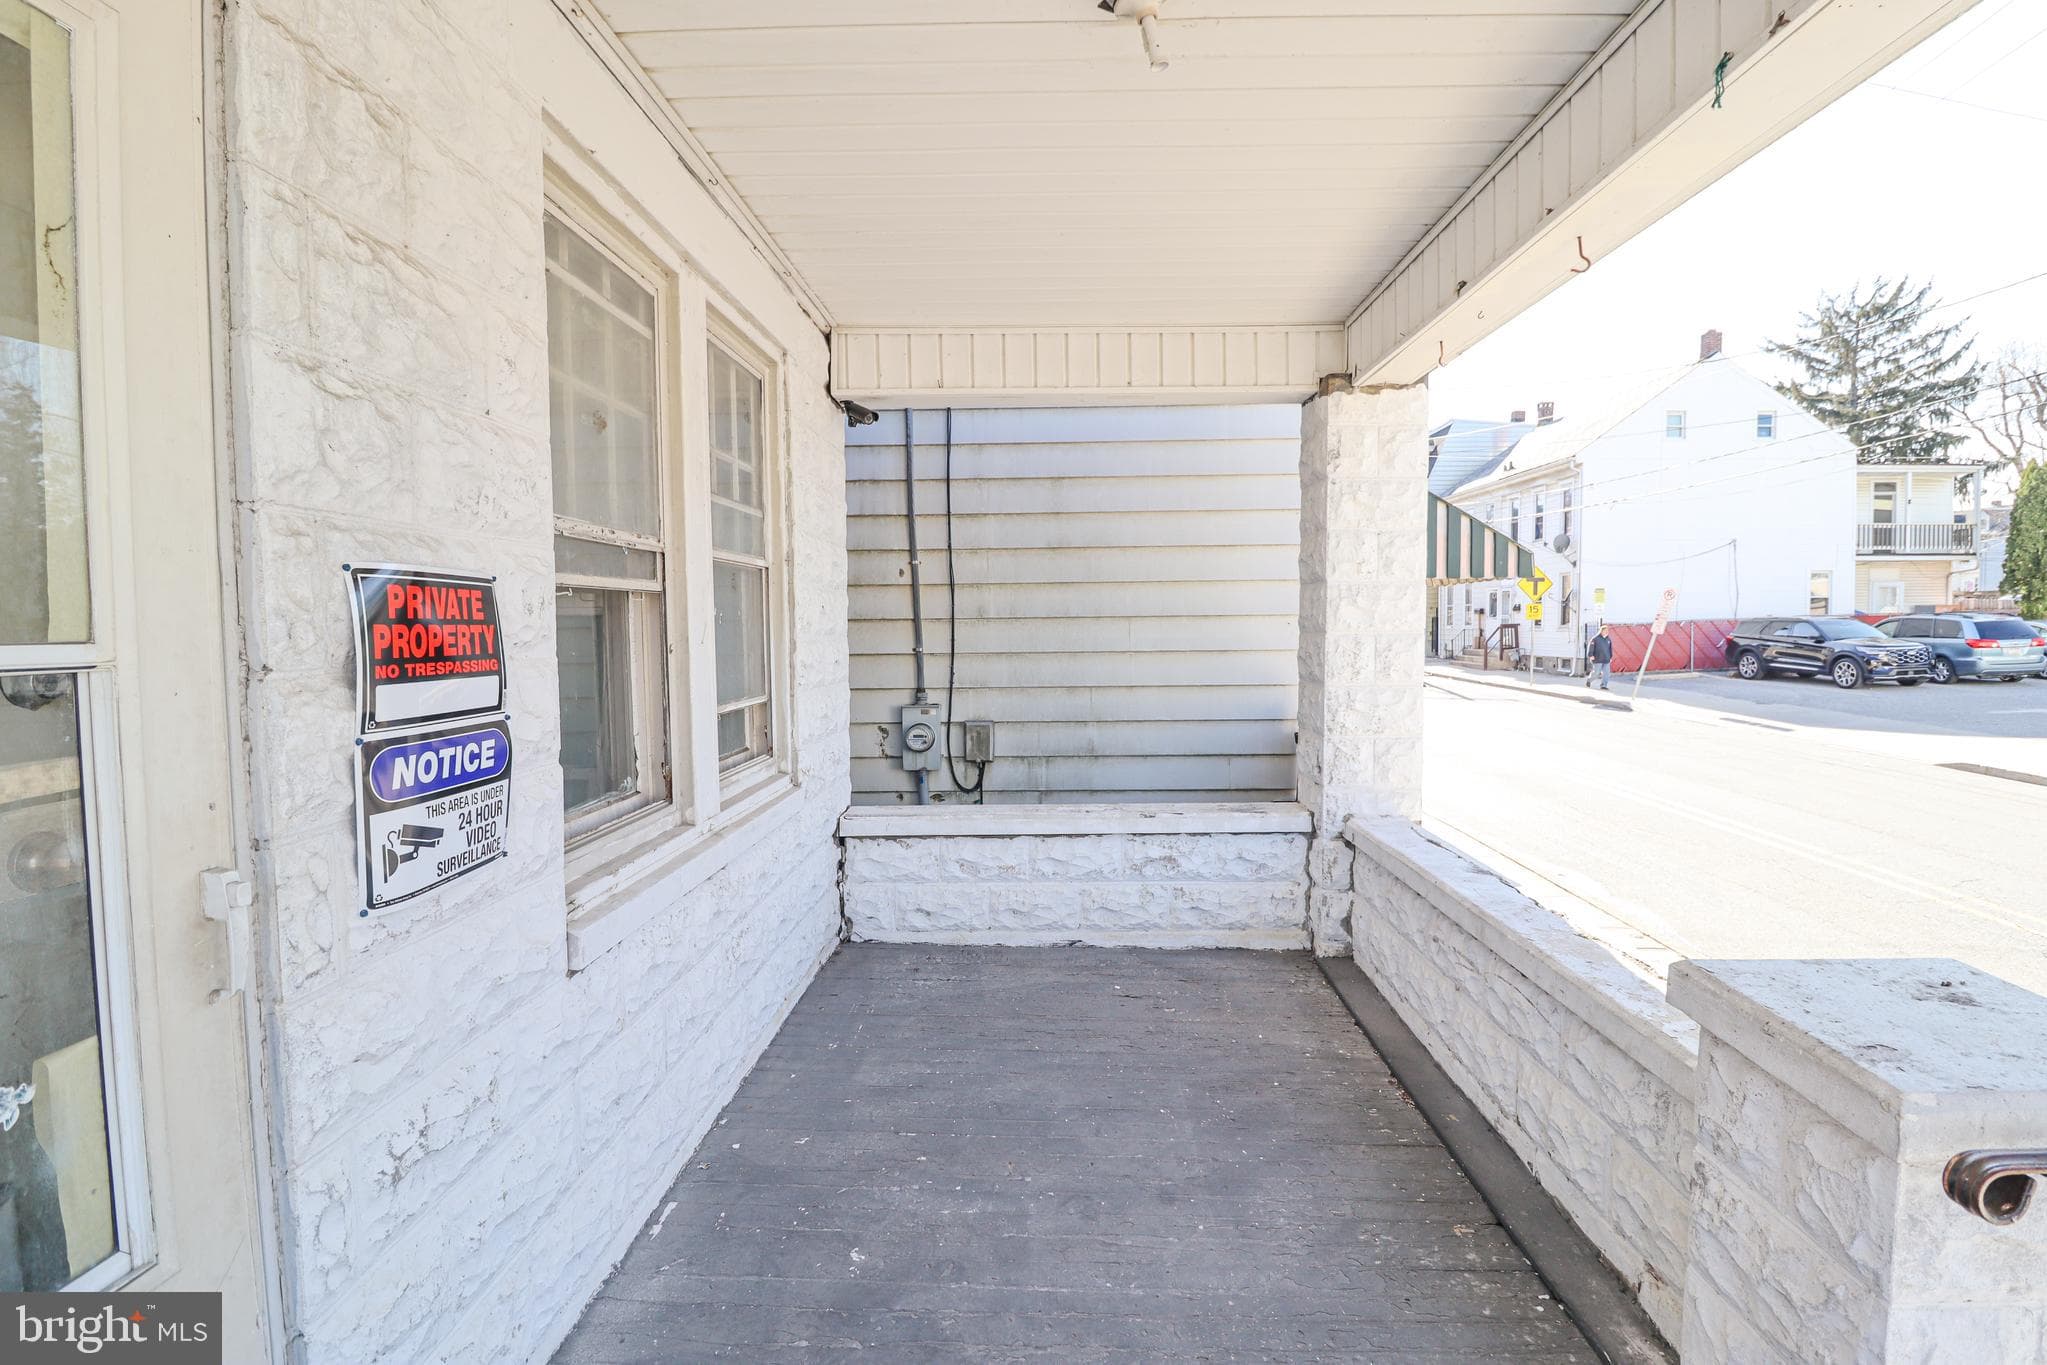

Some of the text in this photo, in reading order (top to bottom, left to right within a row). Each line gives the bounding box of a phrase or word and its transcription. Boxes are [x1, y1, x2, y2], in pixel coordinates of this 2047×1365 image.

[386, 583, 485, 621] PRIVATE
[1530, 605, 1539, 614] 15
[373, 623, 495, 660] PROPERTY
[375, 659, 499, 680] NO TRESPASSING
[391, 738, 496, 791] NOTICE
[426, 784, 504, 819] THIS AREA IS UNDER
[458, 799, 503, 831] 24 HOUR
[466, 820, 497, 847] VIDEO
[436, 836, 501, 877] SURVEILLANCE
